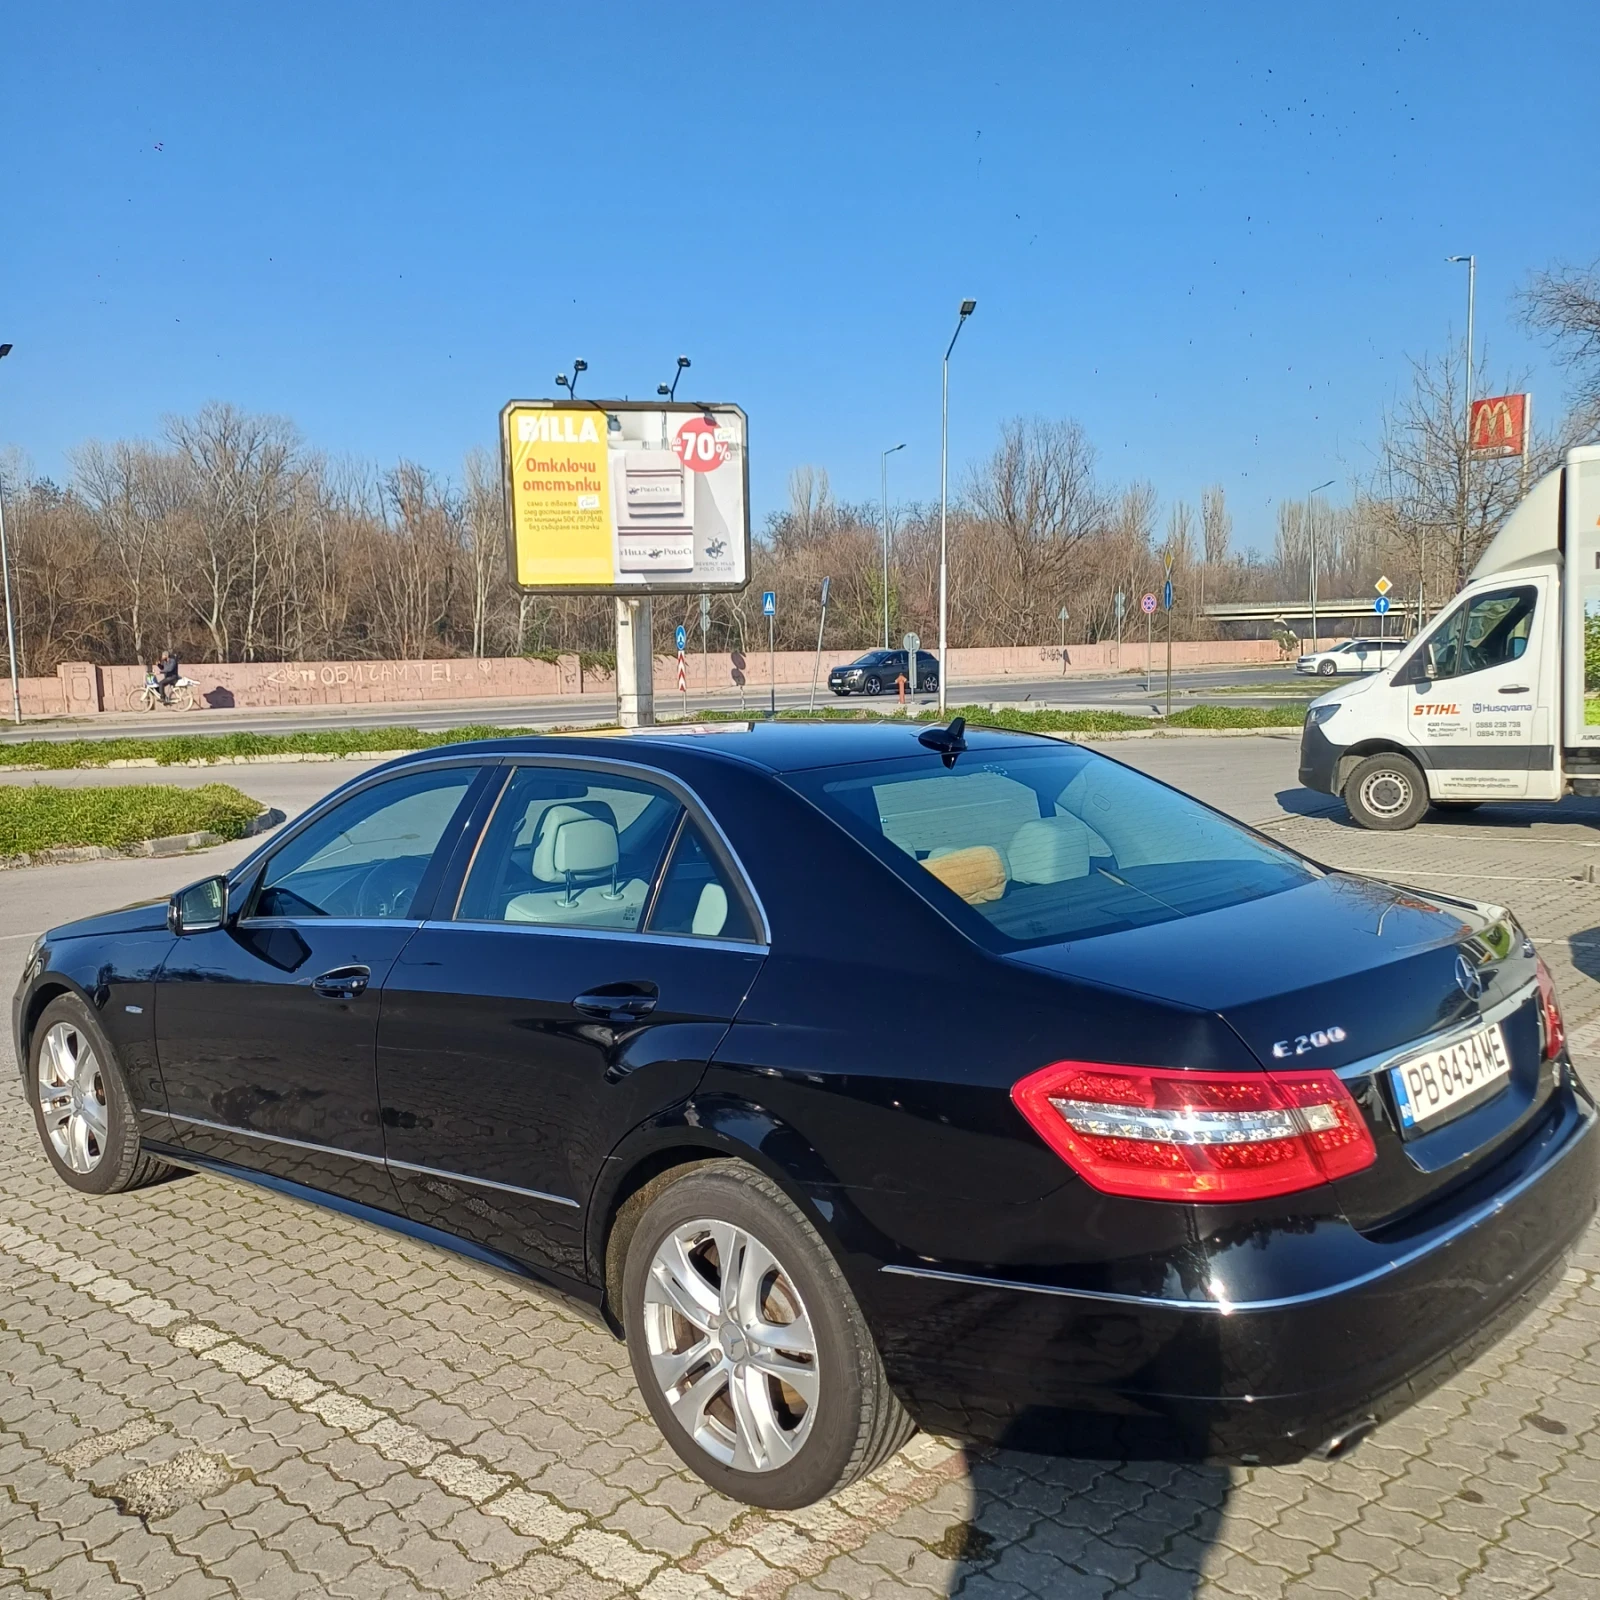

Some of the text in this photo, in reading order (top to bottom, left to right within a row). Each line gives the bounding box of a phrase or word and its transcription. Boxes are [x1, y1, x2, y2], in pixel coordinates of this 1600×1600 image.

[517, 415, 600, 443] BILLA
[526, 457, 596, 472] Отключи
[523, 476, 601, 491] отстъпки
[1413, 703, 1461, 716] STIHL
[1482, 703, 1533, 713] Husqvarna
[1272, 1026, 1347, 1058] E 200
[1406, 1026, 1506, 1113] PB 8434 ME
